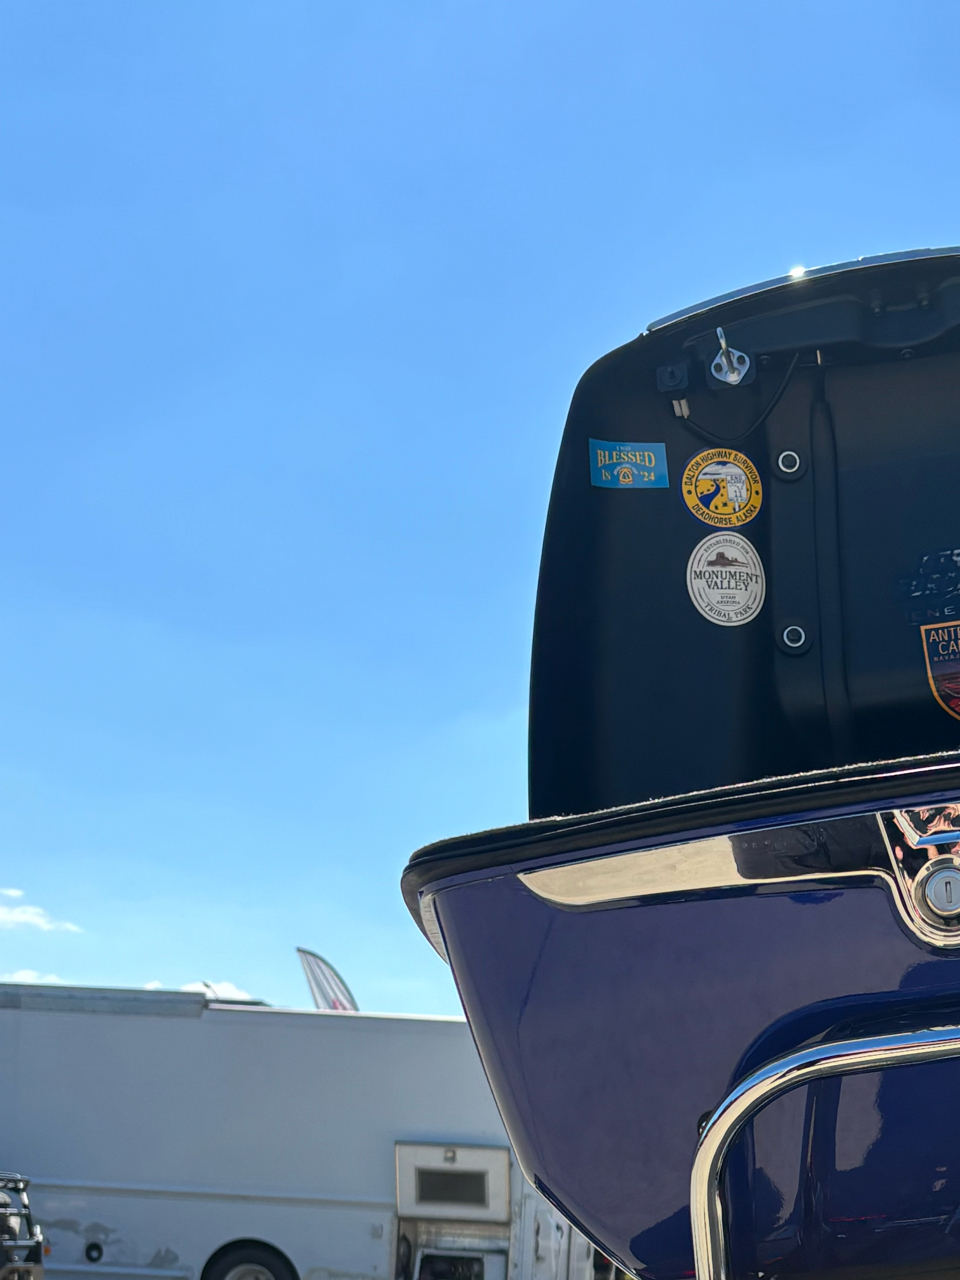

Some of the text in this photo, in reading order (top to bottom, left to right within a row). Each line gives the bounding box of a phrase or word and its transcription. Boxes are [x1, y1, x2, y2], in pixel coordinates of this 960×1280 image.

[597, 449, 655, 468] BLESSED
[684, 450, 760, 486] DALTON HIGHWAY SURVIVOR
[691, 503, 758, 526] DEADHORSE, ALASKA
[704, 538, 741, 553] ESTABLISHED
[693, 570, 760, 584] MONUMENT
[706, 580, 750, 591] VALLEY
[704, 602, 753, 619] TRIBAL PARK
